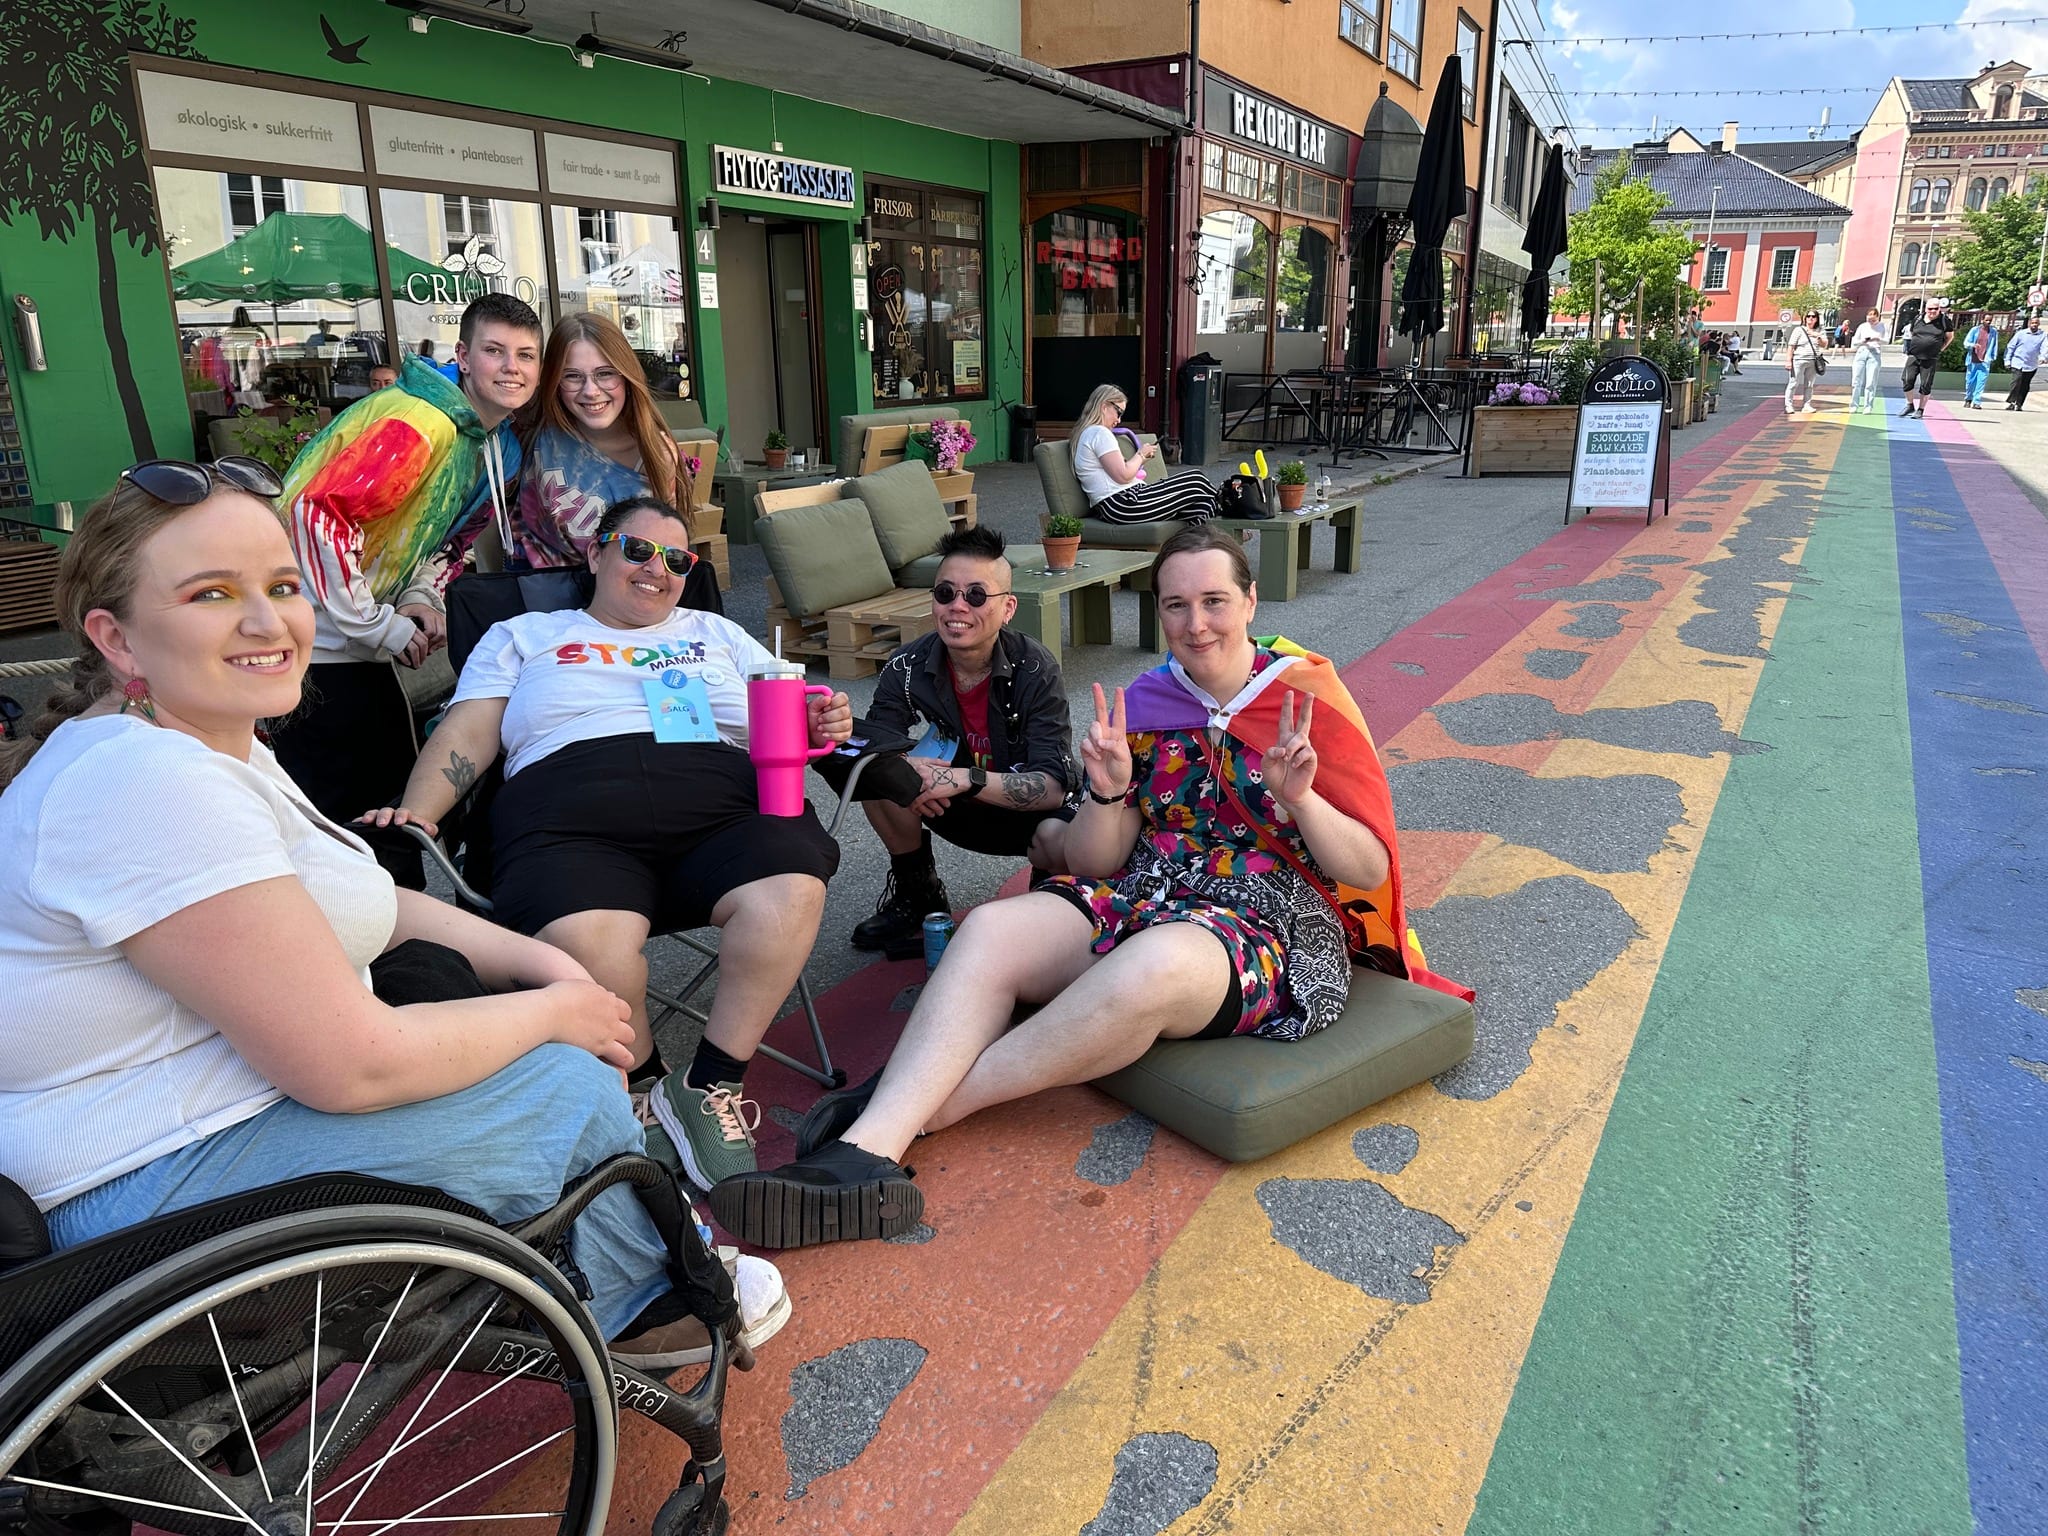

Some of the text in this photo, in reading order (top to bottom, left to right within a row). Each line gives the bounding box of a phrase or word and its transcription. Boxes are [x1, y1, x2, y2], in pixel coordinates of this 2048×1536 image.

[177, 108, 333, 142] økologisk sukkerfritt
[1233, 91, 1327, 165] REKORD BAR
[388, 136, 524, 166] glutenfritt plantebasert
[562, 159, 661, 184] fair trade sunt & godt
[873, 197, 914, 218] FRISØR
[698, 232, 711, 260] 4
[854, 246, 863, 271] 4
[1037, 237, 1142, 264] REKORD
[876, 274, 901, 292] OPEN
[1062, 265, 1117, 290] BAR
[1594, 379, 1656, 394] CRIOLLO
[1590, 443, 1644, 453] RAW KAKER
[1583, 467, 1645, 476] Plantebasert
[556, 640, 706, 667] STOLT
[649, 656, 708, 672] MAMMA
